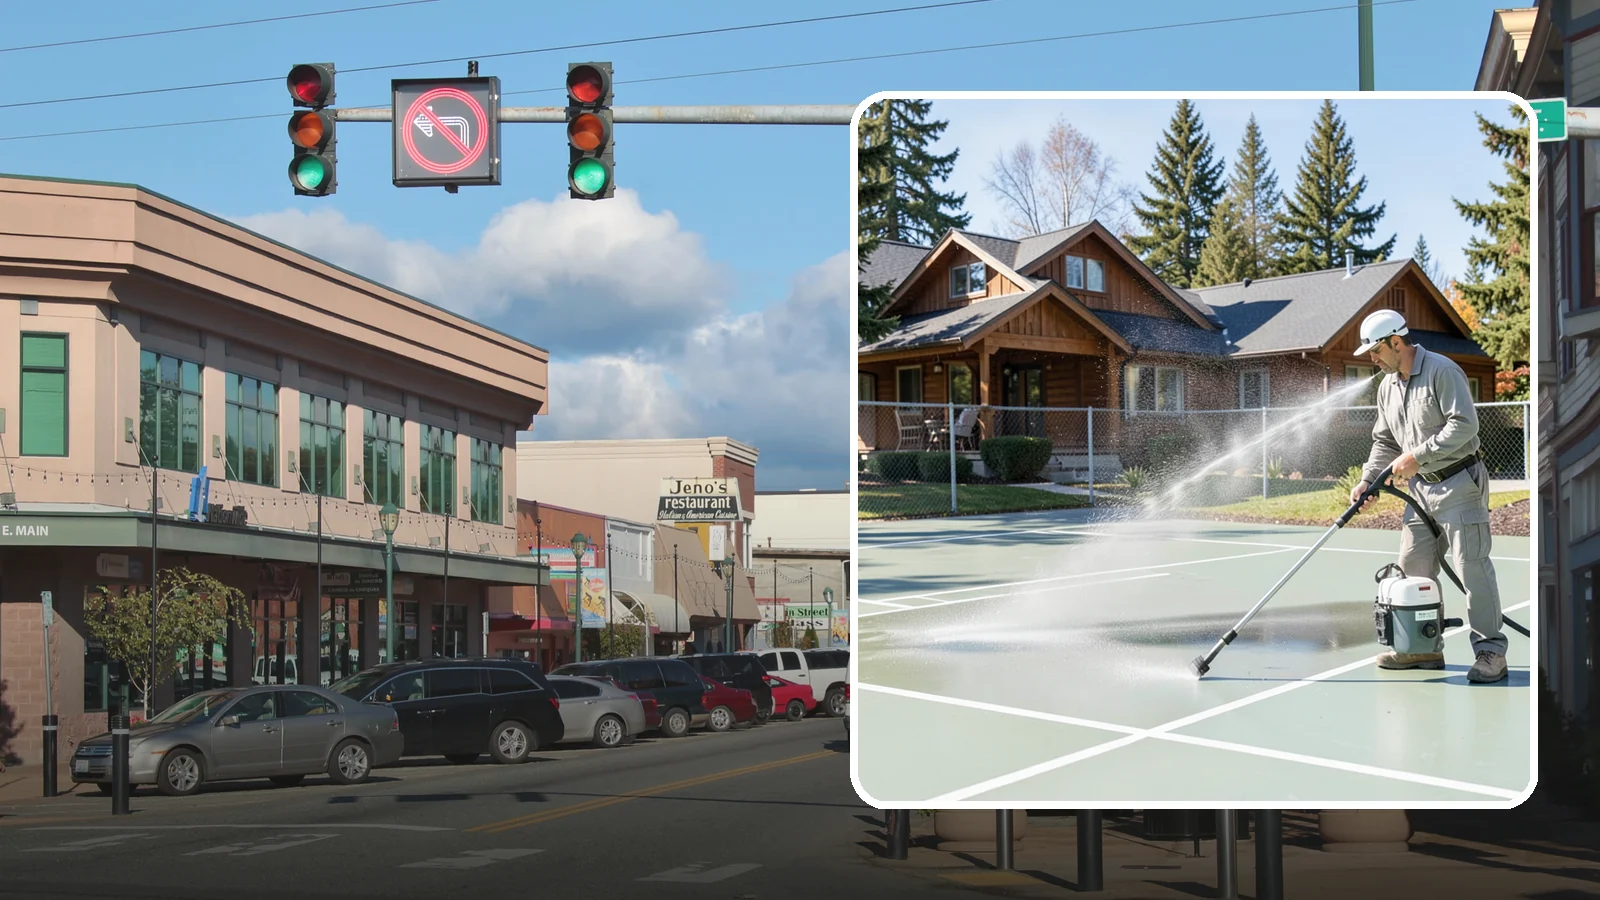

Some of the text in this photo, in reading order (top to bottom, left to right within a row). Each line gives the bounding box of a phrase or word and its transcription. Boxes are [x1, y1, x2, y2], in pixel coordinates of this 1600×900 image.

[670, 480, 727, 494] Jeno's
[665, 496, 731, 509] restaurant
[658, 510, 681, 519] Italian
[686, 509, 714, 519] American
[715, 509, 738, 519] Cuisine
[2, 525, 49, 536] E. MAIN
[797, 607, 829, 617] Street
